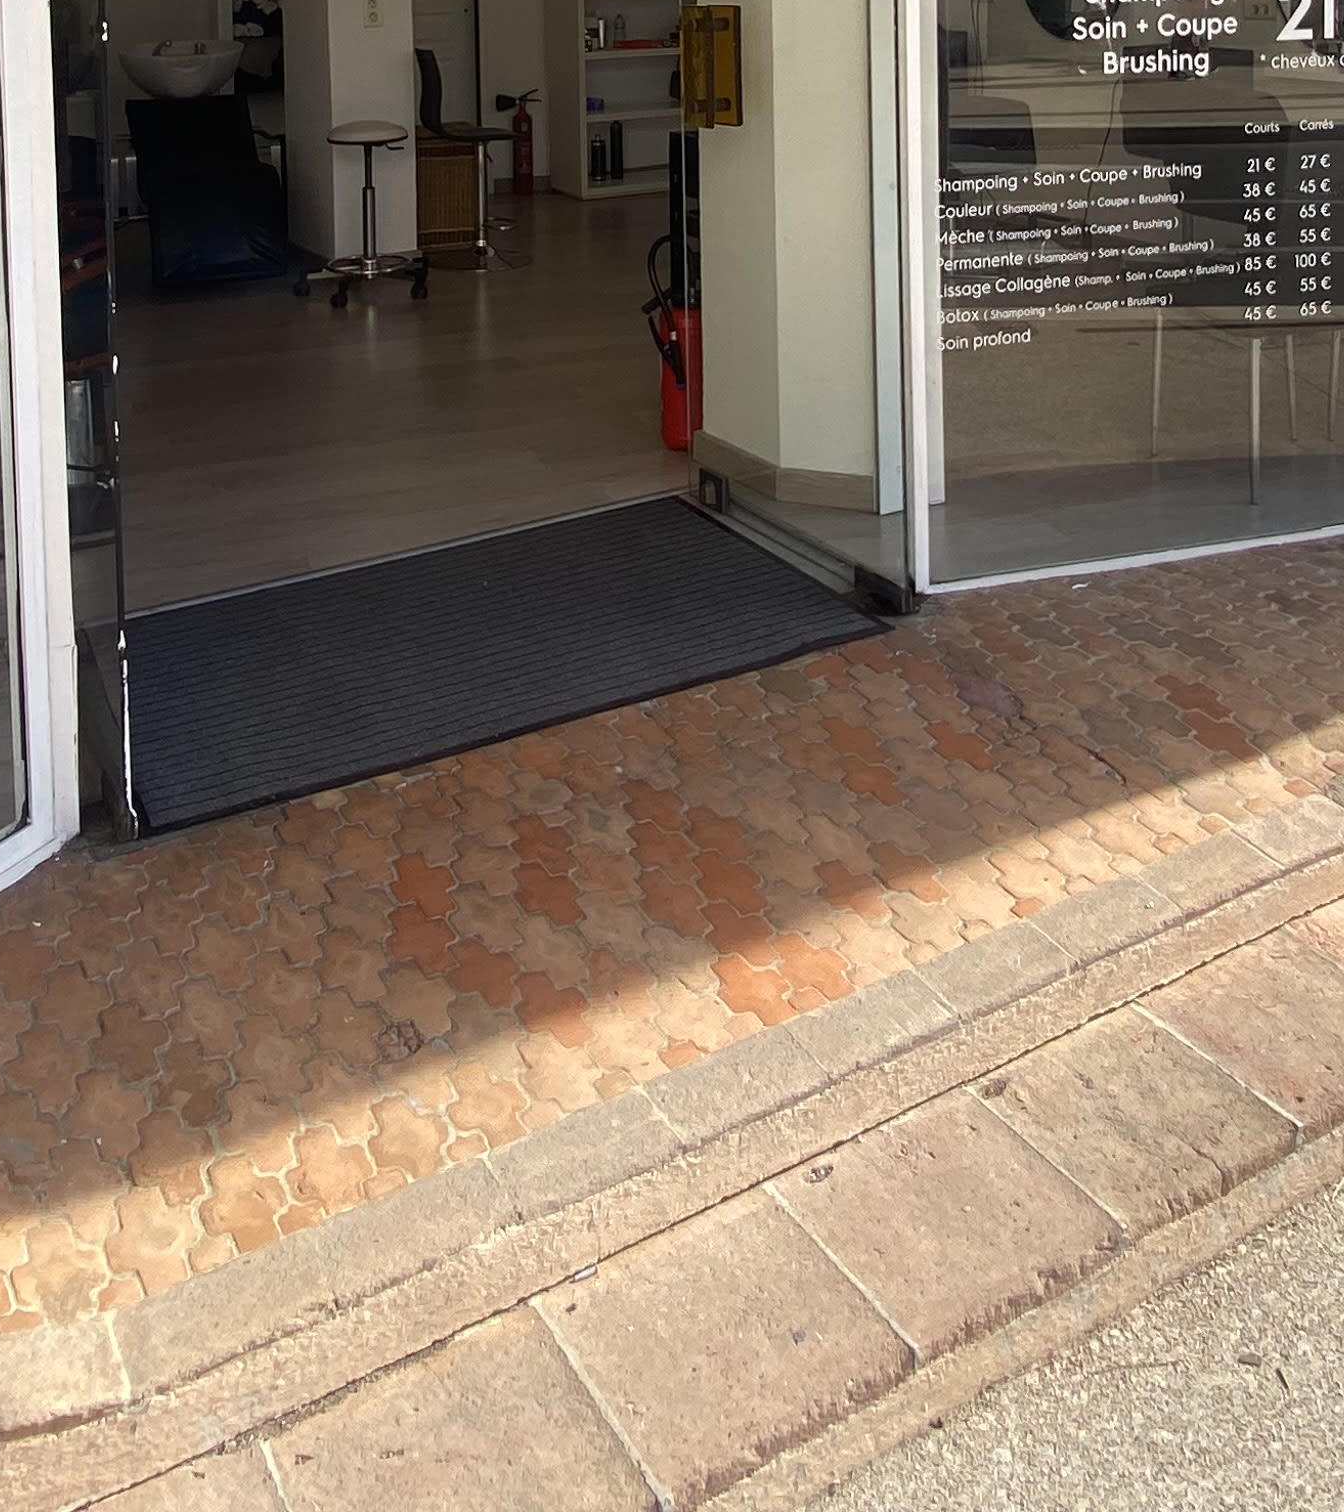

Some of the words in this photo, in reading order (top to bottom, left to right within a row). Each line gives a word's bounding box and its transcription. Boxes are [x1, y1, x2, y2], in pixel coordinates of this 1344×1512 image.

[1073, 16, 1126, 41] Soin
[1137, 21, 1149, 32] +
[1158, 14, 1237, 40] Coupe
[1103, 49, 1210, 78] Brushing
[1271, 51, 1334, 69] cheveux
[1245, 122, 1280, 134] Courts
[1299, 119, 1334, 131] Carrés
[1247, 158, 1259, 173] 21
[1265, 157, 1276, 171] €
[1300, 155, 1316, 169] 27
[1320, 154, 1331, 168] €
[935, 175, 1017, 192] Shampoing
[1034, 171, 1064, 185] Soin
[1080, 169, 1127, 184] Coupe
[1144, 163, 1202, 179] Brushing
[1243, 183, 1260, 198] 38
[1265, 182, 1276, 196] €
[1299, 180, 1316, 194] 45
[1320, 178, 1331, 192] €
[935, 204, 992, 219] Couleur
[1067, 200, 1087, 210] Soin
[1098, 197, 1129, 208] Coupe
[1244, 208, 1261, 222] 45
[1265, 207, 1276, 221] €
[1299, 204, 1316, 219] 65
[1320, 203, 1331, 217] €
[1061, 225, 1081, 236] Soin
[1090, 223, 1121, 235] Coupe
[1243, 233, 1261, 248] 38
[1265, 232, 1276, 246] €
[1299, 229, 1316, 243] 55
[1321, 227, 1331, 241] €
[936, 254, 1023, 272] Permanente
[1098, 249, 1118, 258] Soin
[1128, 246, 1159, 257] Coupe
[1245, 257, 1261, 271] 85
[1265, 256, 1276, 269] €
[1295, 253, 1316, 268] 100
[1321, 252, 1331, 266] €
[995, 275, 1070, 294] Collagène
[1126, 271, 1146, 282] Soin
[1156, 269, 1186, 279] Coupe
[1245, 281, 1261, 296] 45
[1265, 280, 1276, 294] €
[1300, 277, 1316, 292] 55
[1321, 276, 1331, 290] €
[936, 311, 979, 324] Botox
[1055, 303, 1076, 313] Soin
[1085, 299, 1118, 312] Coupe
[1245, 306, 1261, 321] 45
[1265, 305, 1276, 319] €
[1300, 302, 1317, 316] 65
[1321, 300, 1331, 314] €
[936, 336, 968, 351] Soin
[973, 328, 1031, 350] profond
